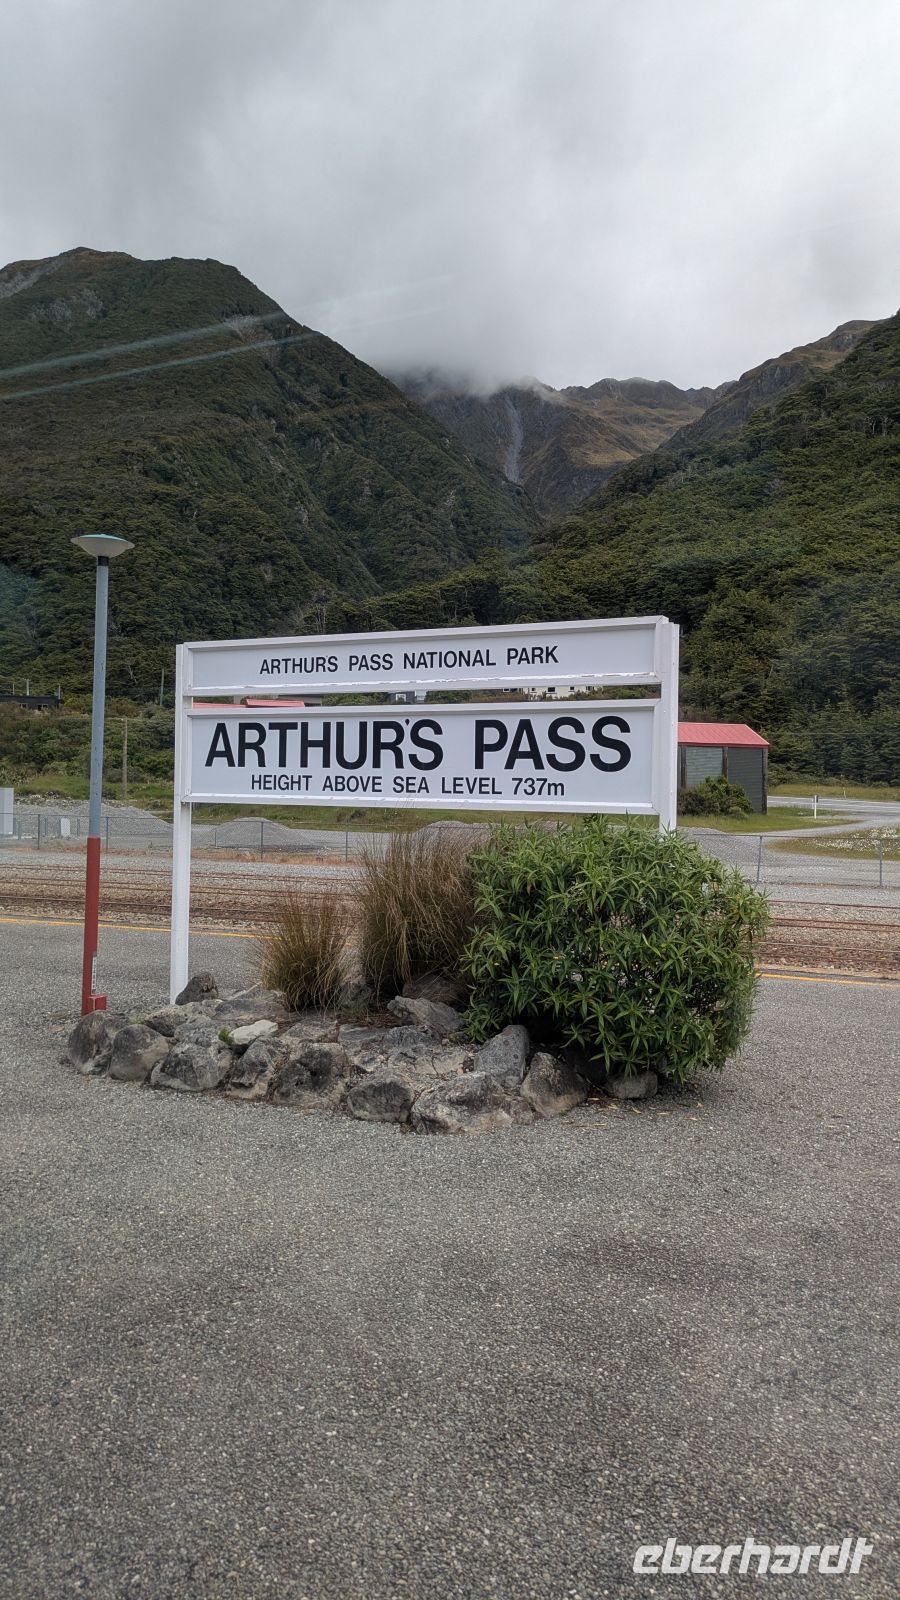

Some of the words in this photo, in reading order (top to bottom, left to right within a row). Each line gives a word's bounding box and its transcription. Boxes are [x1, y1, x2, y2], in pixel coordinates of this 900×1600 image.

[348, 653, 394, 672] PASS
[403, 648, 497, 670] NATIONAL
[506, 645, 559, 666] PARK
[204, 718, 444, 771] ARTHUR'S
[474, 715, 632, 773] PASS
[251, 774, 313, 791] HEIGHT
[322, 775, 383, 793] ABOVE
[392, 776, 430, 794] SEA
[441, 776, 503, 795] LEVEL
[511, 777, 565, 796] 737m
